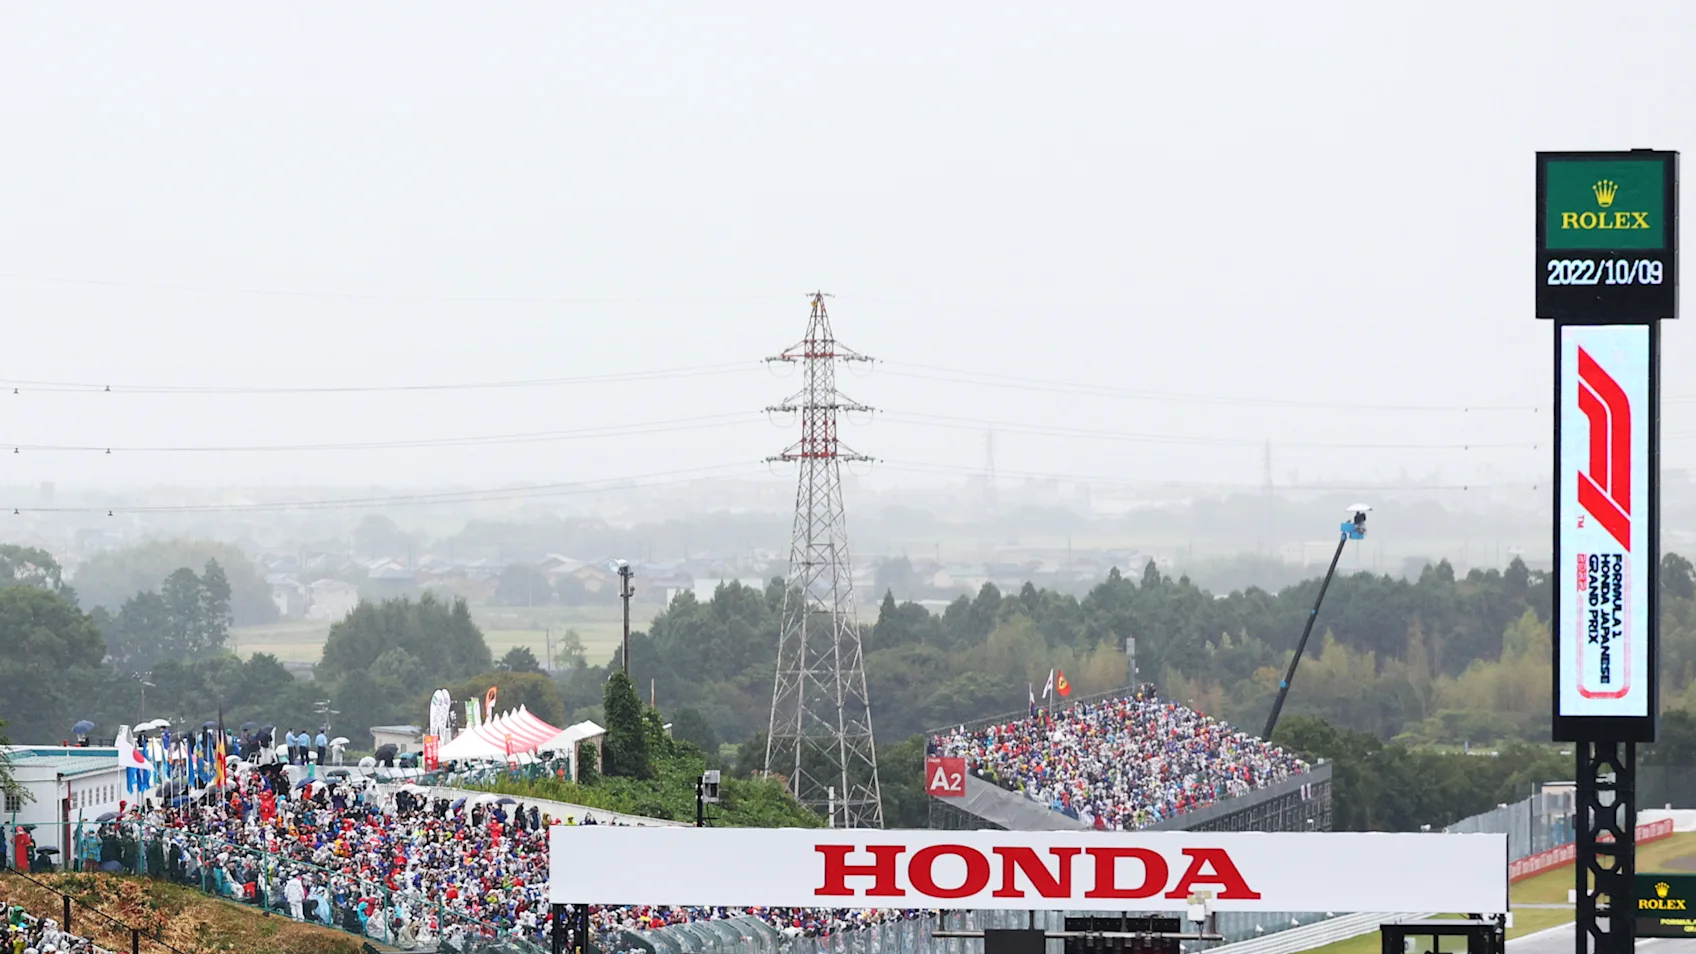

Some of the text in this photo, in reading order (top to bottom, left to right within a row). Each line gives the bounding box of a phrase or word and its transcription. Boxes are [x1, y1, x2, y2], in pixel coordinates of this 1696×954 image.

[1561, 211, 1650, 229] ROLEX
[1547, 259, 1664, 285] 2022/10/09
[1588, 554, 1599, 644] GRAND PRIX
[1612, 553, 1622, 627] FORMULA
[1600, 553, 1610, 684] HONDA JAPANESE
[929, 766, 962, 791] A2
[814, 843, 1262, 900] HONDA
[1638, 898, 1687, 910] ROLEX
